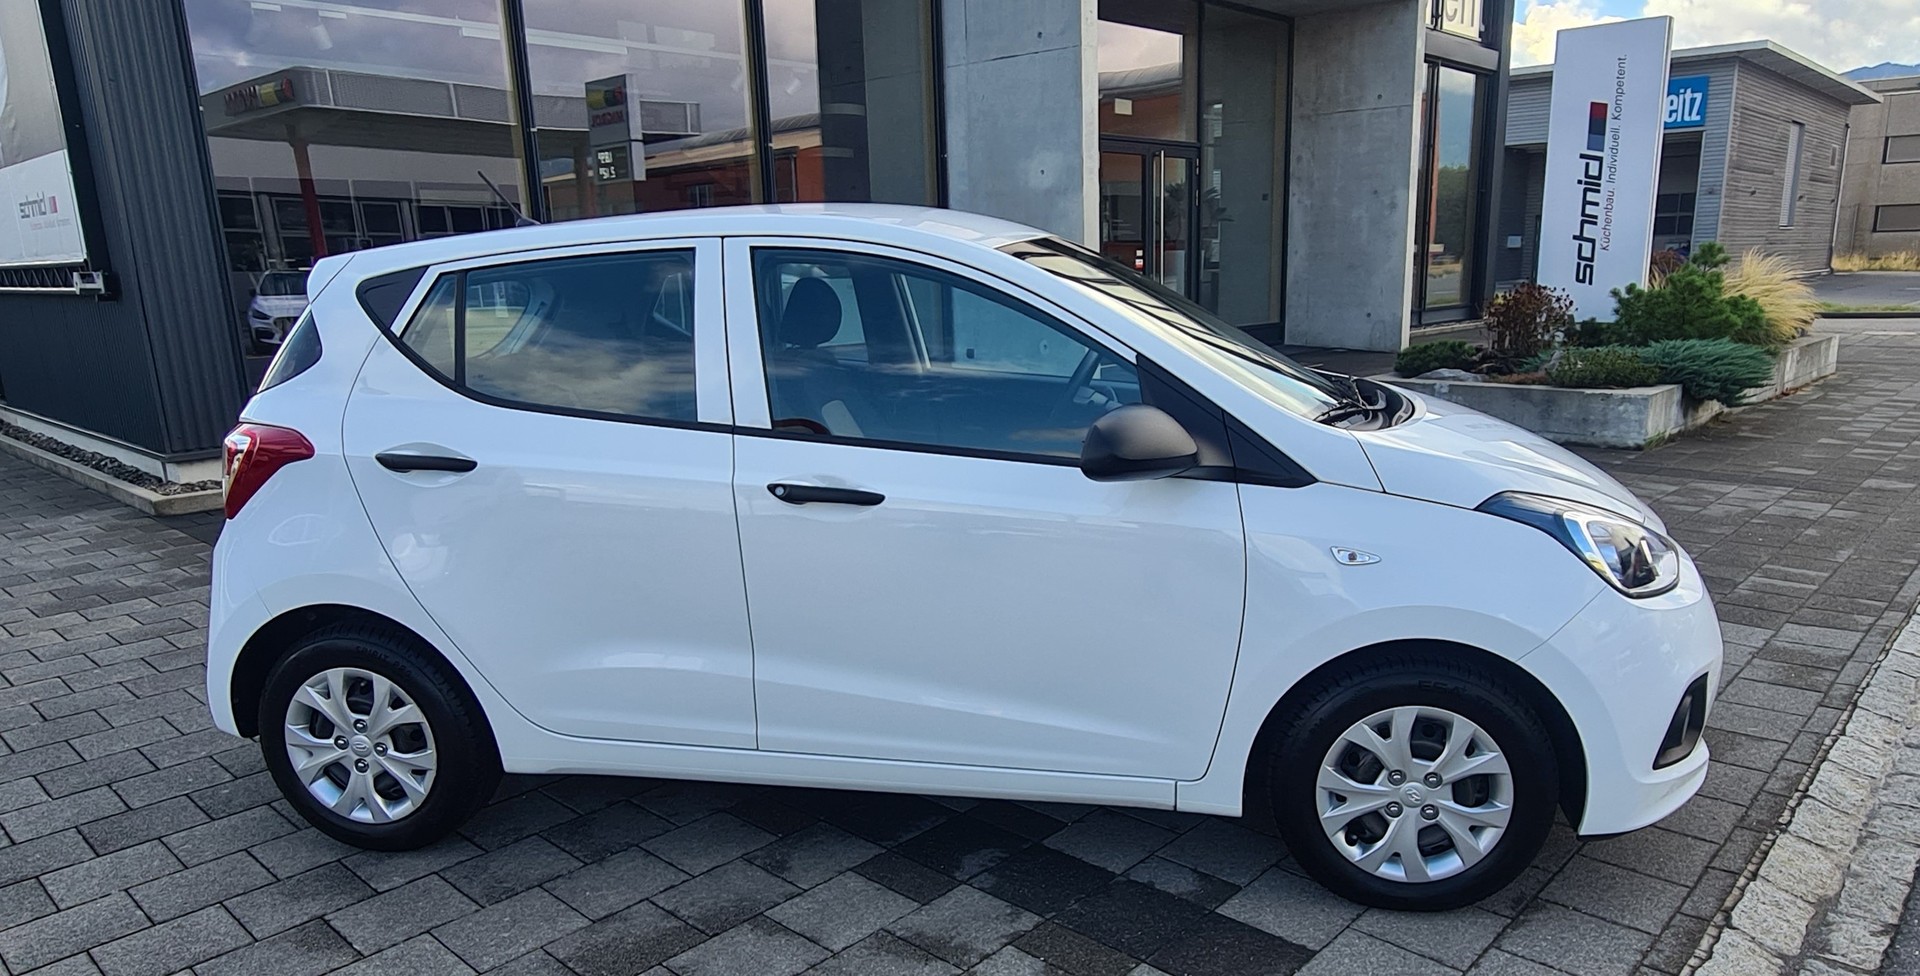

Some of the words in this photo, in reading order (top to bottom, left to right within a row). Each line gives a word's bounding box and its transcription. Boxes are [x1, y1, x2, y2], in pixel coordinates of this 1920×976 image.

[1611, 54, 1628, 121] Kompetent.
[1606, 125, 1621, 184] Individuell.
[1572, 153, 1604, 286] schmid
[1600, 187, 1616, 251] Küchenbau.
